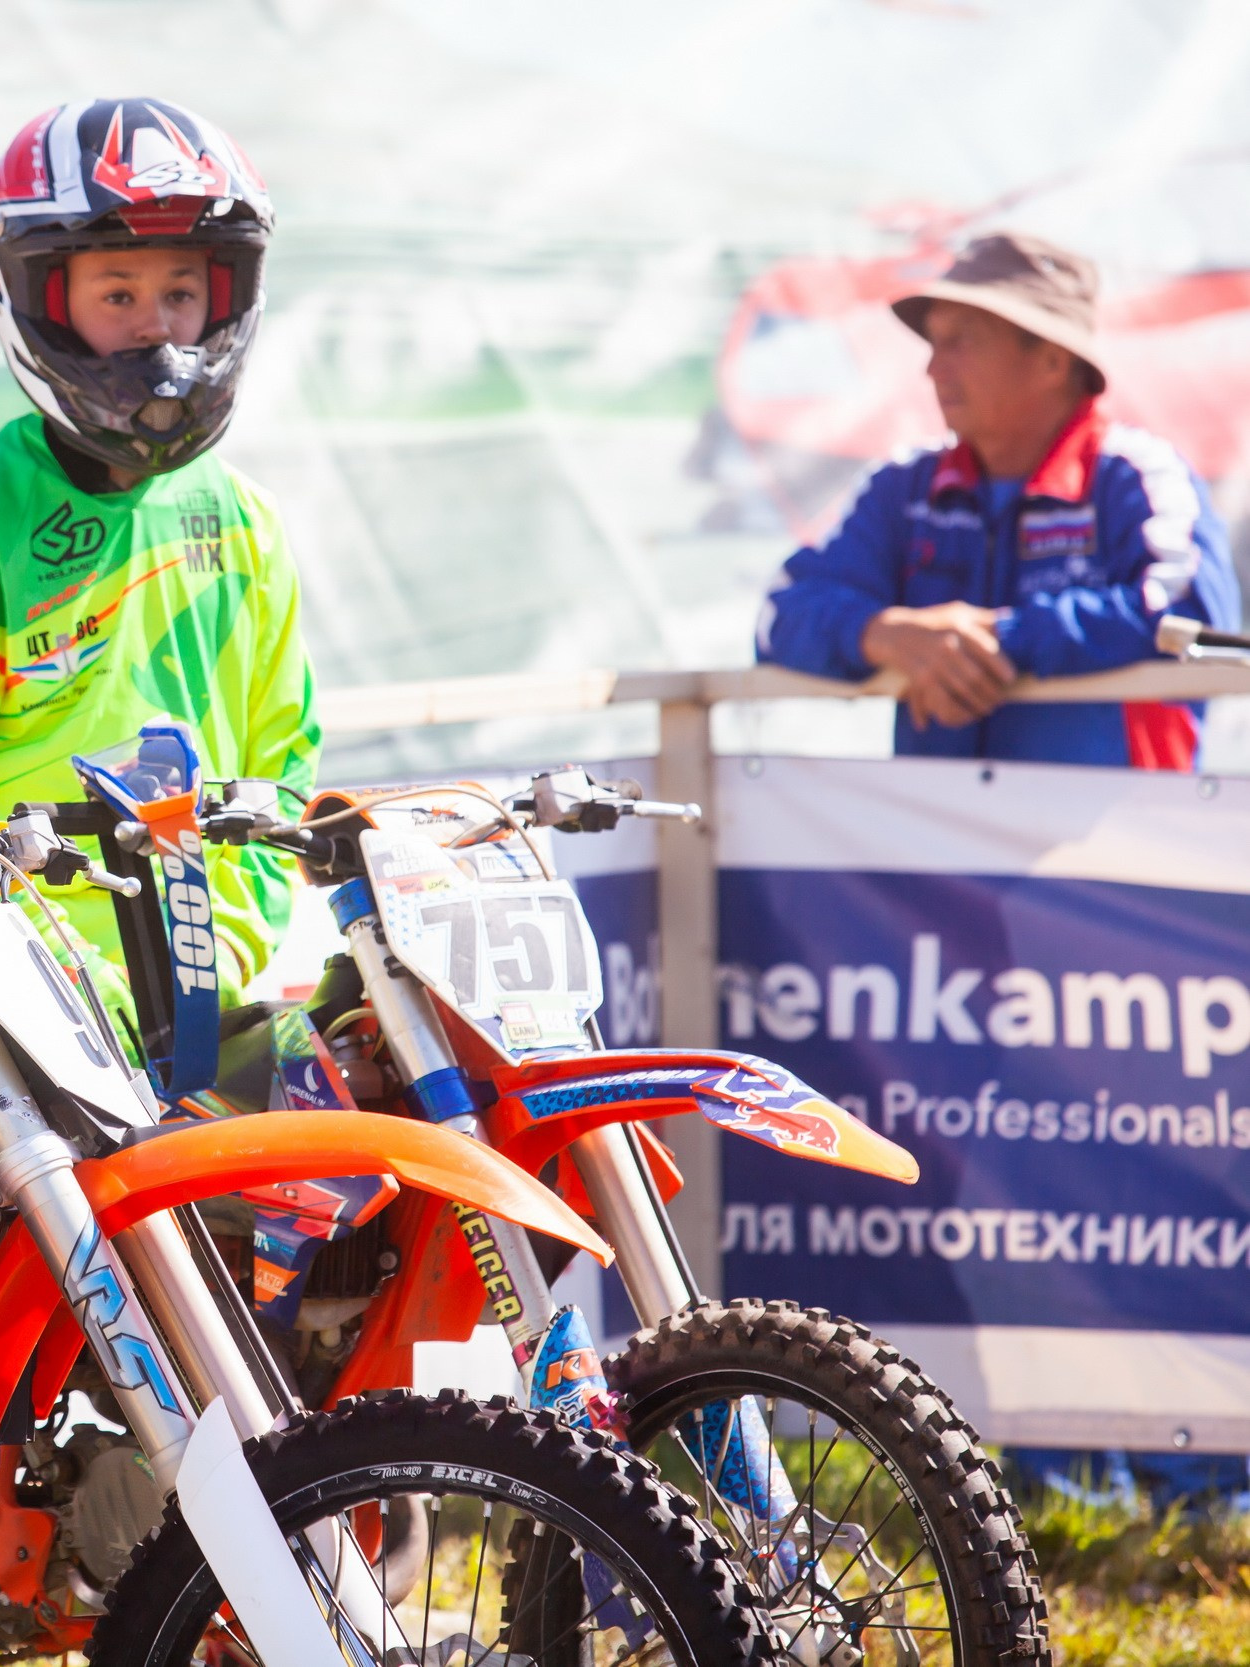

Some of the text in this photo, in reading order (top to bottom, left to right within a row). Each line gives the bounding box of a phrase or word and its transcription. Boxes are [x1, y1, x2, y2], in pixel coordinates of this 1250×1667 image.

[180, 514, 222, 541] 100
[155, 829, 217, 996] 100%
[419, 896, 589, 1007] 757
[26, 938, 112, 1069] 9
[431, 1464, 498, 1488] EXCEL
[507, 1481, 537, 1500] Rim
